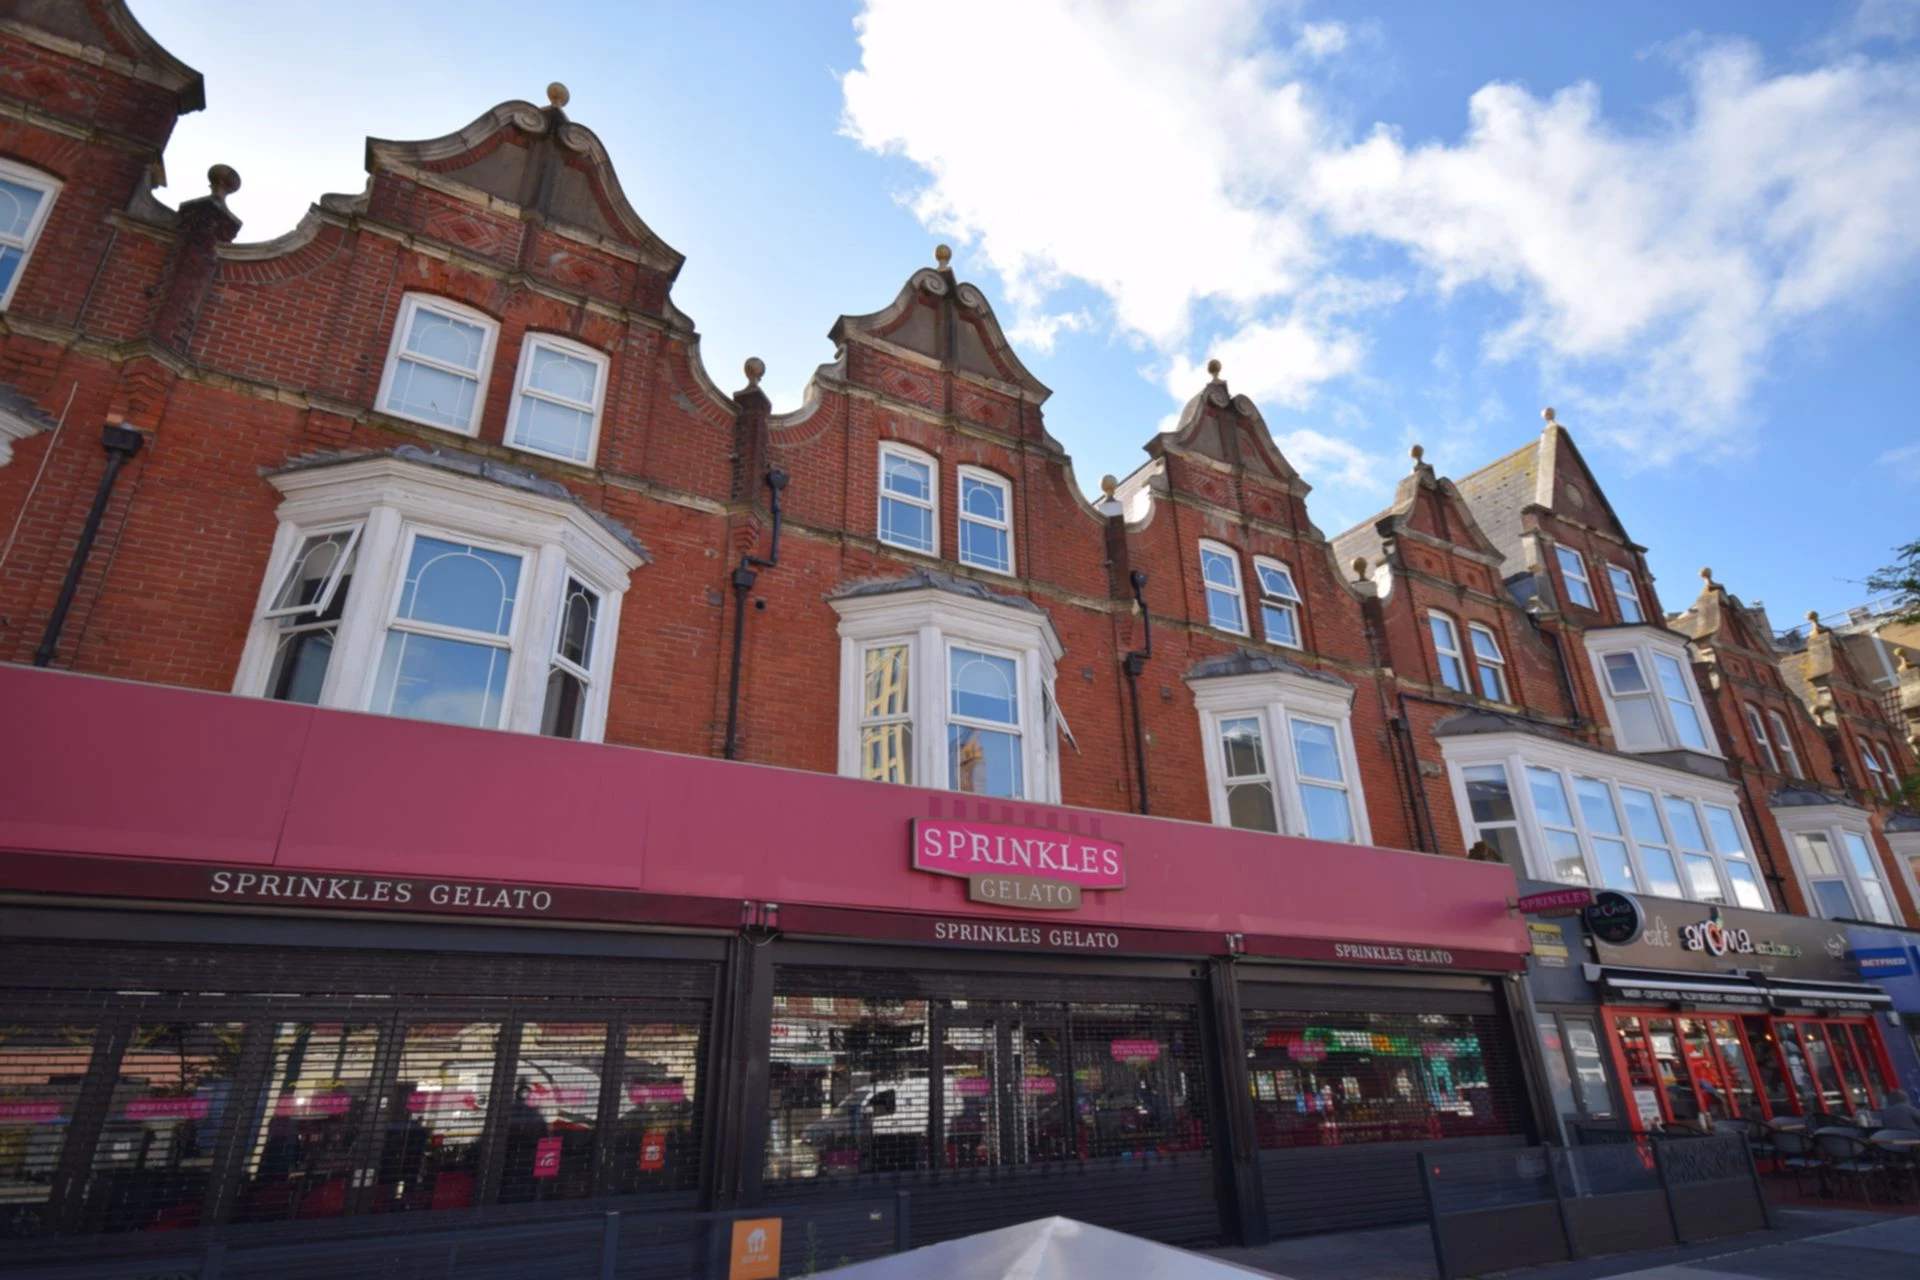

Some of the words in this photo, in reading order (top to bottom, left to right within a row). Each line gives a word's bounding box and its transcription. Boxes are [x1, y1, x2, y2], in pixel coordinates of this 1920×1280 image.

[923, 827, 1120, 876] SPRINKLES
[210, 871, 413, 904] SPRINKLES
[429, 884, 553, 911] GELATO
[979, 878, 1073, 904] GELATO
[1519, 891, 1590, 909] SPRINKLES
[934, 921, 1042, 944] SPRINKLES
[1049, 929, 1120, 949] GELATO
[1334, 942, 1404, 961] SPRINKLES
[1407, 948, 1454, 965] GELATO
[1860, 957, 1907, 968] BETFRED
